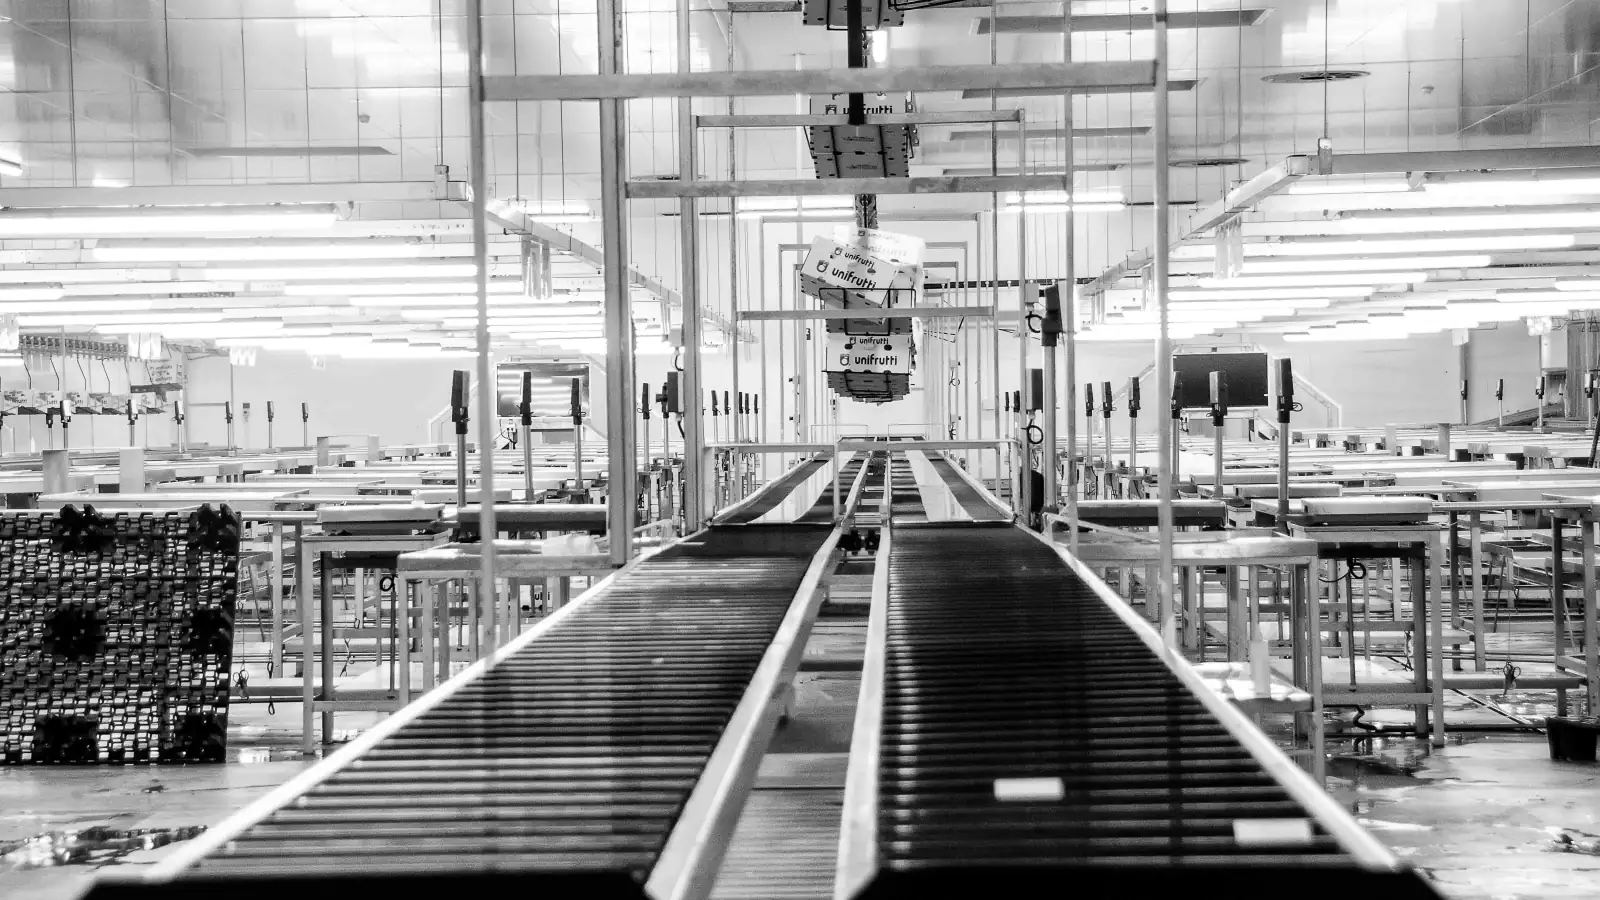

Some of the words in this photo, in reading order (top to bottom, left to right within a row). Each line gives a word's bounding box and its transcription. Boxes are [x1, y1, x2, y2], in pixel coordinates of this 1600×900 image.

[845, 251, 875, 268] unifrutti
[832, 267, 876, 290] unifrutti
[859, 337, 889, 346] unifrutti
[854, 353, 898, 366] unifrutti
